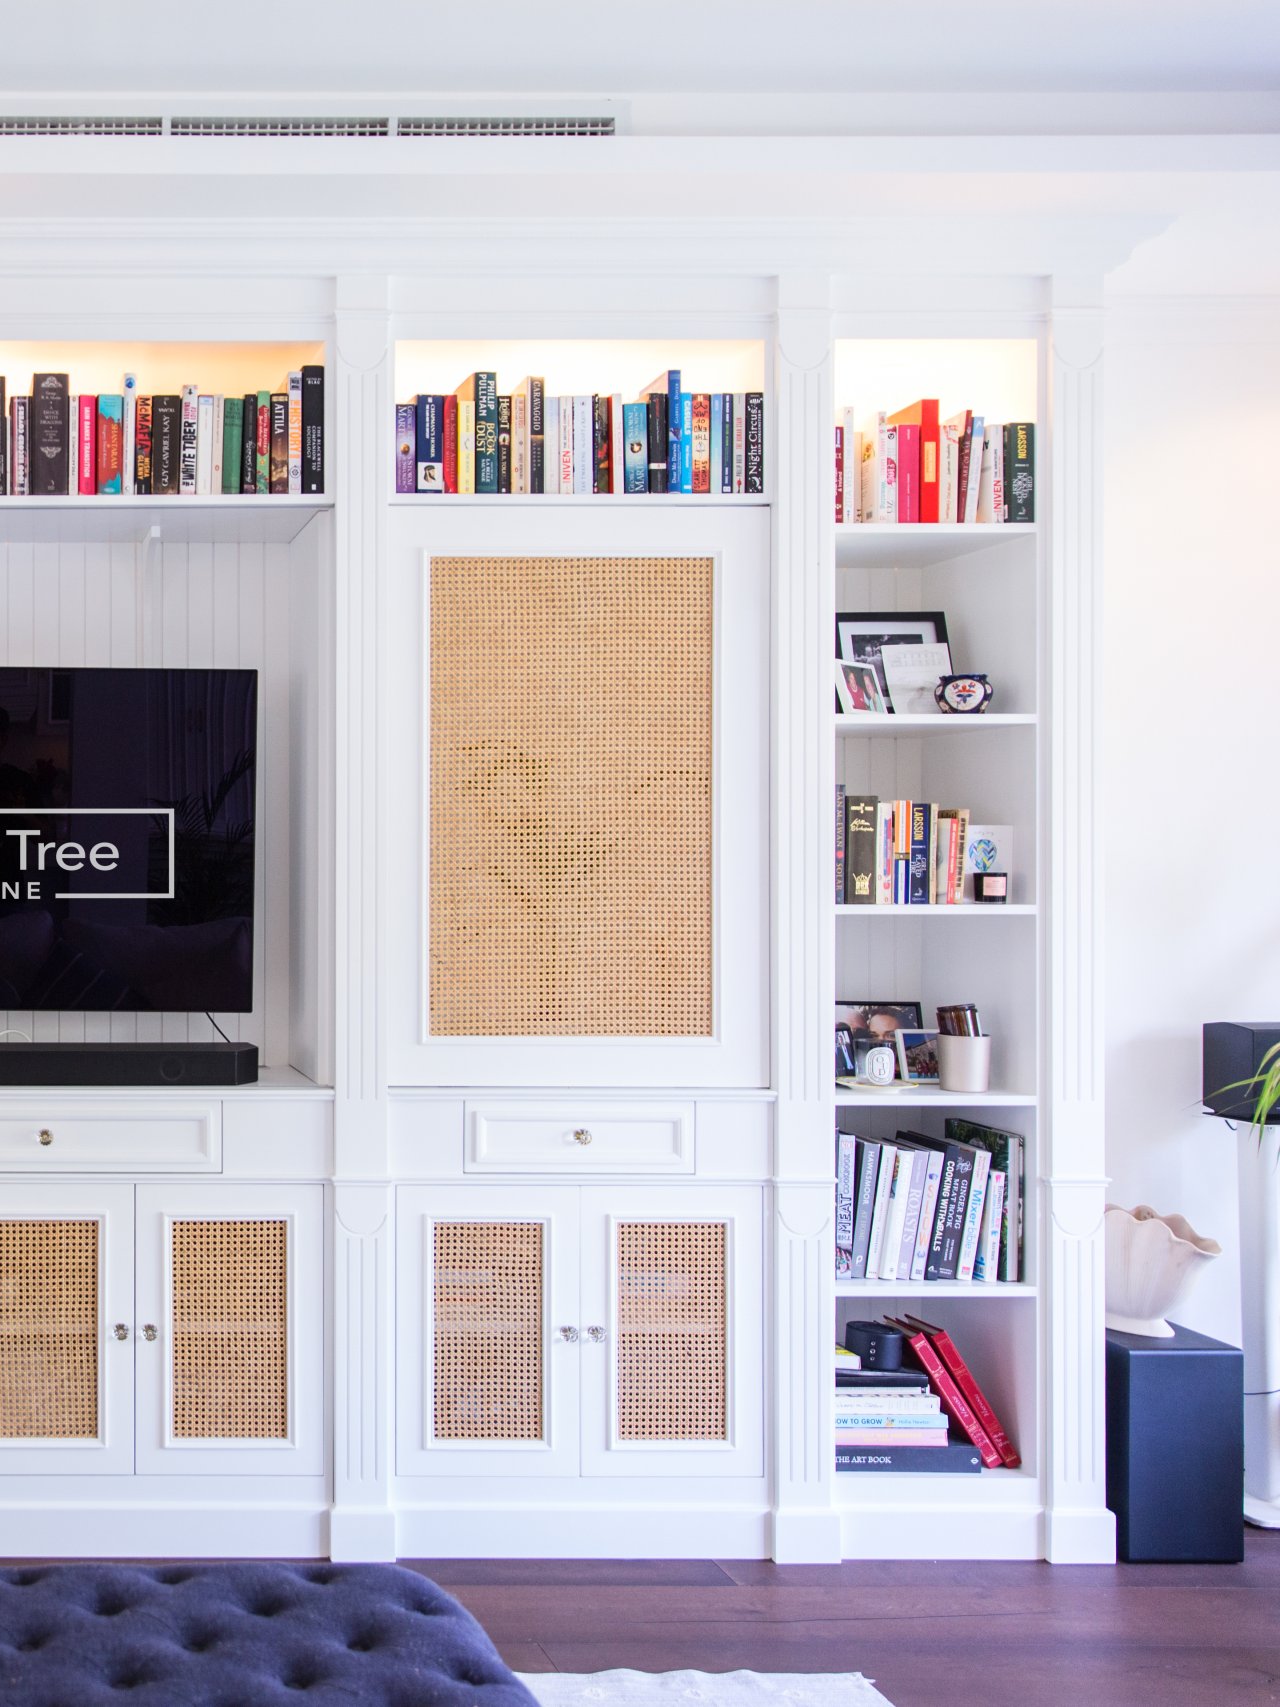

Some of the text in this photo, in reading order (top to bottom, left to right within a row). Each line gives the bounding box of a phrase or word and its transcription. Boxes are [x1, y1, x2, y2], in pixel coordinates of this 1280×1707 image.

[479, 373, 487, 416] PULLMAN
[487, 380, 495, 410] PHILIP
[533, 381, 541, 431] CARAVAGGIO
[275, 403, 284, 434] ATTILA
[290, 407, 301, 452] HISTORY
[111, 423, 119, 469] SHANTARAM
[183, 420, 197, 452] TIGER
[476, 423, 485, 453] DUST
[487, 422, 495, 456] BOOK
[749, 409, 760, 475] Night Circus
[1017, 425, 1027, 459] LARSSON
[181, 453, 195, 481] WHITE
[312, 462, 317, 470] TO
[562, 450, 571, 481] NIVEN
[993, 479, 1001, 510] NIVEN
[913, 807, 923, 841] LARSSON
[6, 829, 120, 871] Tree
[862, 1151, 875, 1205] HAWKSMOOR
[942, 1160, 955, 1197] COOKING
[950, 1177, 960, 1203] MEAT
[903, 1188, 922, 1243] ROASTS
[954, 1179, 968, 1229] GINGER PIG
[968, 1189, 982, 1225] Mixer
[933, 1226, 944, 1252] BALLS
[850, 1456, 867, 1464] ART
[867, 1456, 892, 1464] BOOK
